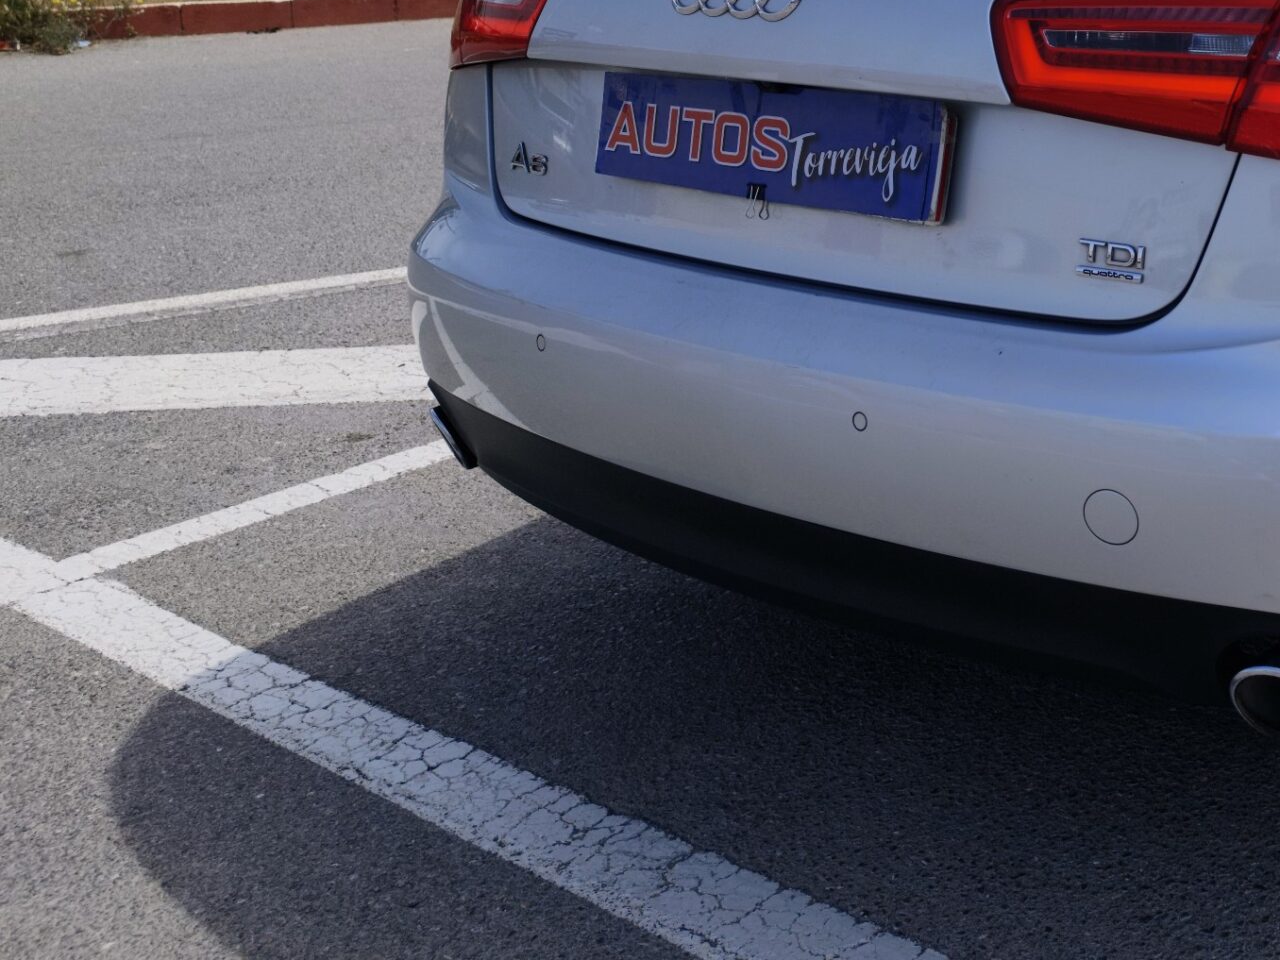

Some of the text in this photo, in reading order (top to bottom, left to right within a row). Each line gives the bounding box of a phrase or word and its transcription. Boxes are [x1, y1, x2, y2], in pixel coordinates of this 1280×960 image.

[604, 101, 923, 202] AUTOS Torrevieja
[1079, 238, 1146, 269] TDI
[1082, 269, 1134, 281] quattro
